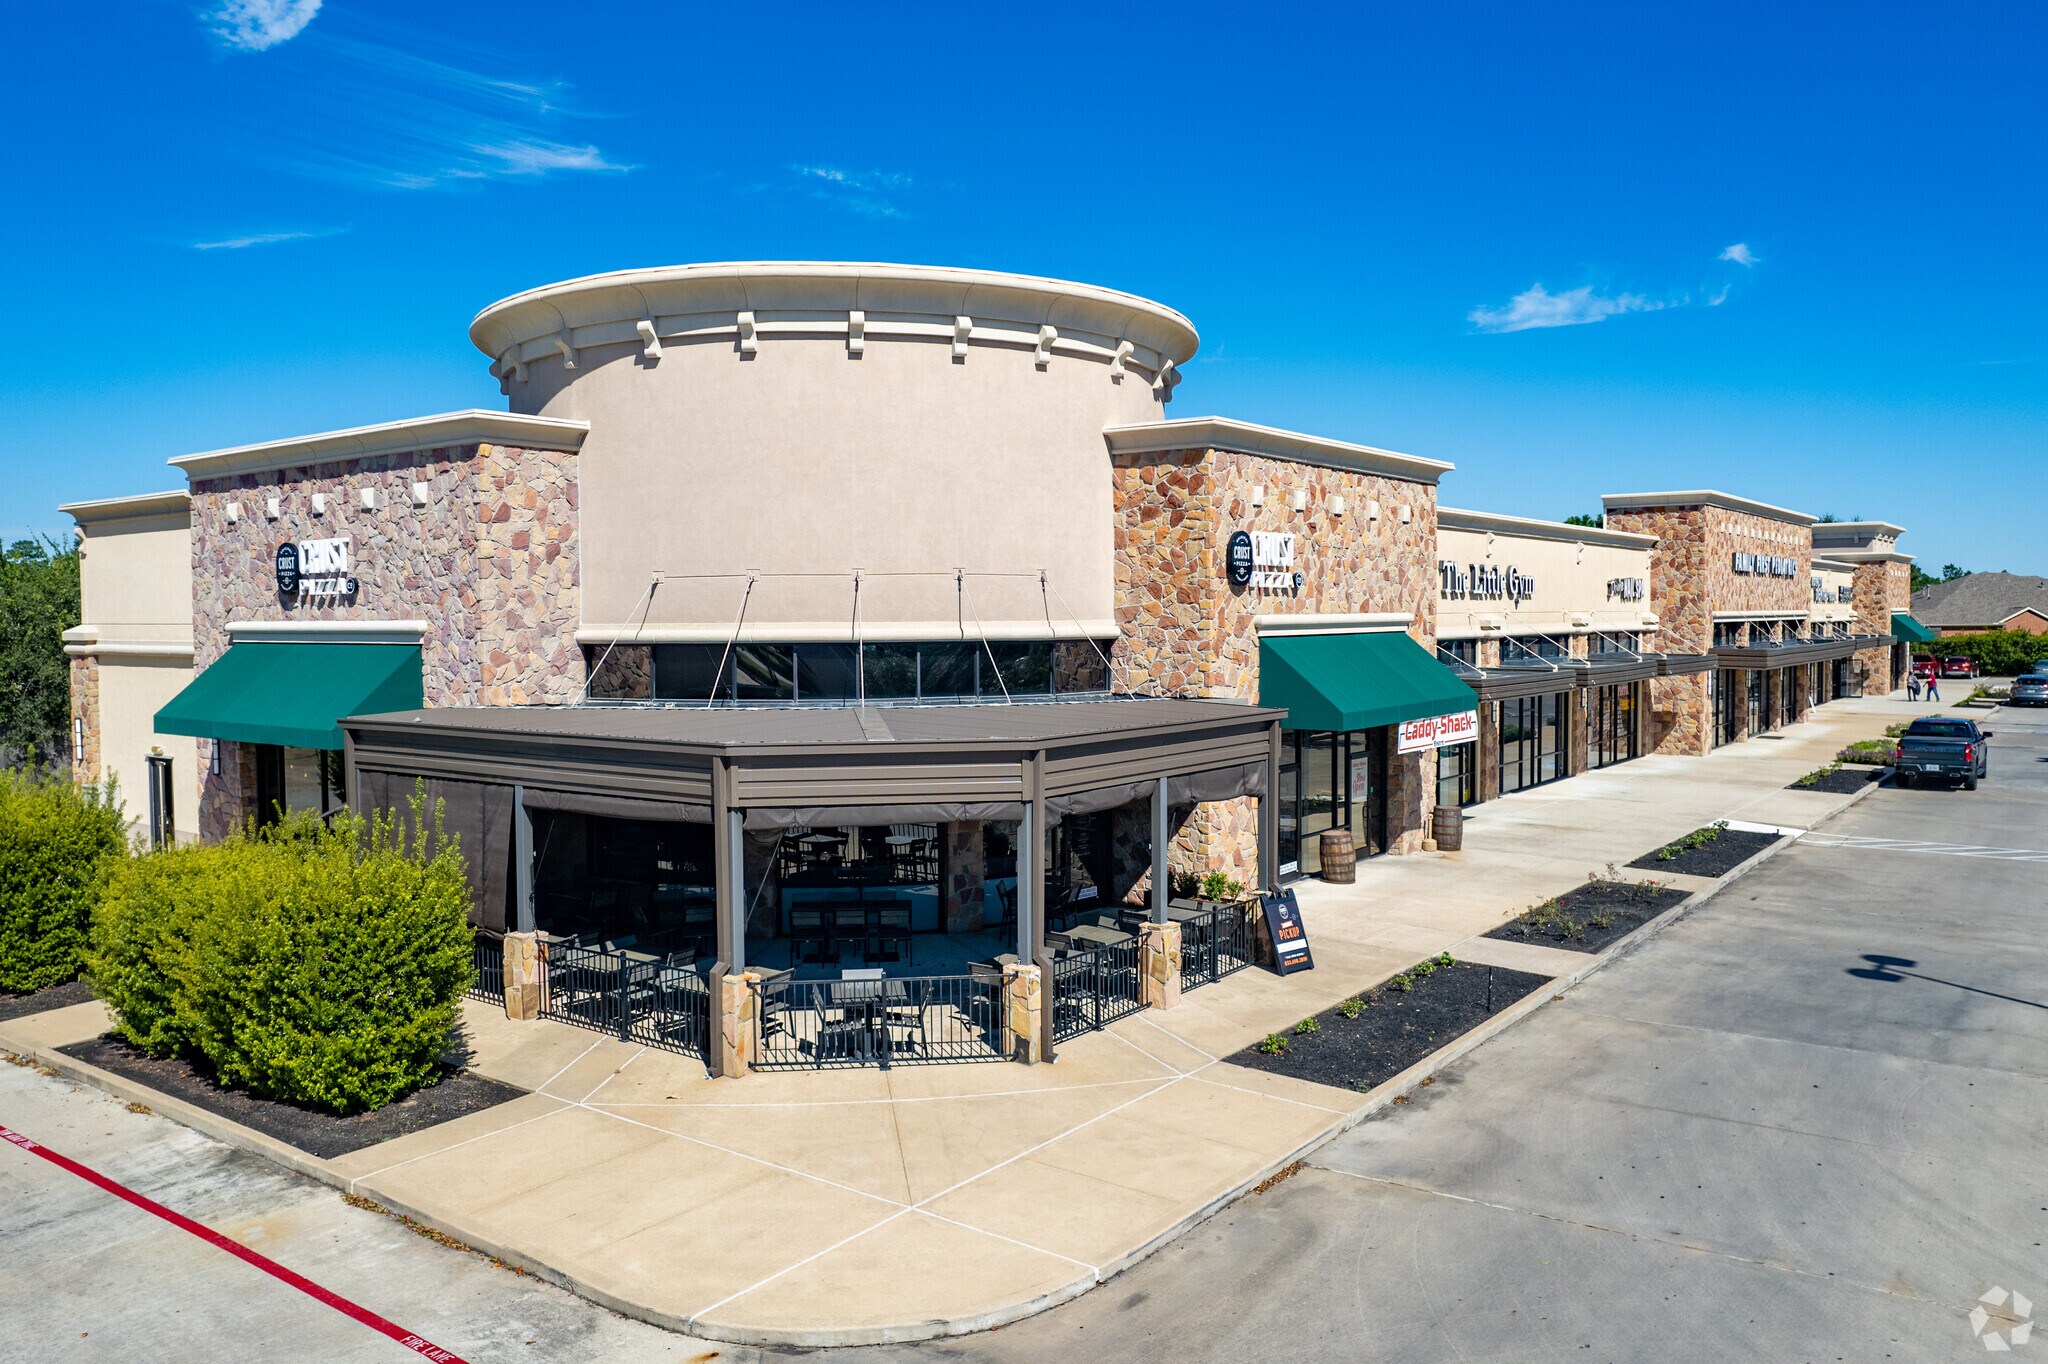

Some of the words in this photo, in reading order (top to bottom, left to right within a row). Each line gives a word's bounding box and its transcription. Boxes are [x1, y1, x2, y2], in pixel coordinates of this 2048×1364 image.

[299, 537, 349, 574] CRUST
[1234, 545, 1251, 560] CRUST
[1250, 531, 1296, 566] CRUST
[278, 556, 295, 570] CRUST
[299, 577, 347, 595] PIZZA
[1250, 571, 1295, 588] PIZZA
[1442, 560, 1470, 594] The
[1473, 563, 1507, 595] Little
[1509, 564, 1535, 603] Gym
[1279, 927, 1300, 940] PICKUP
[400, 1335, 430, 1350] FIRE
[422, 1346, 456, 1363] LANE
